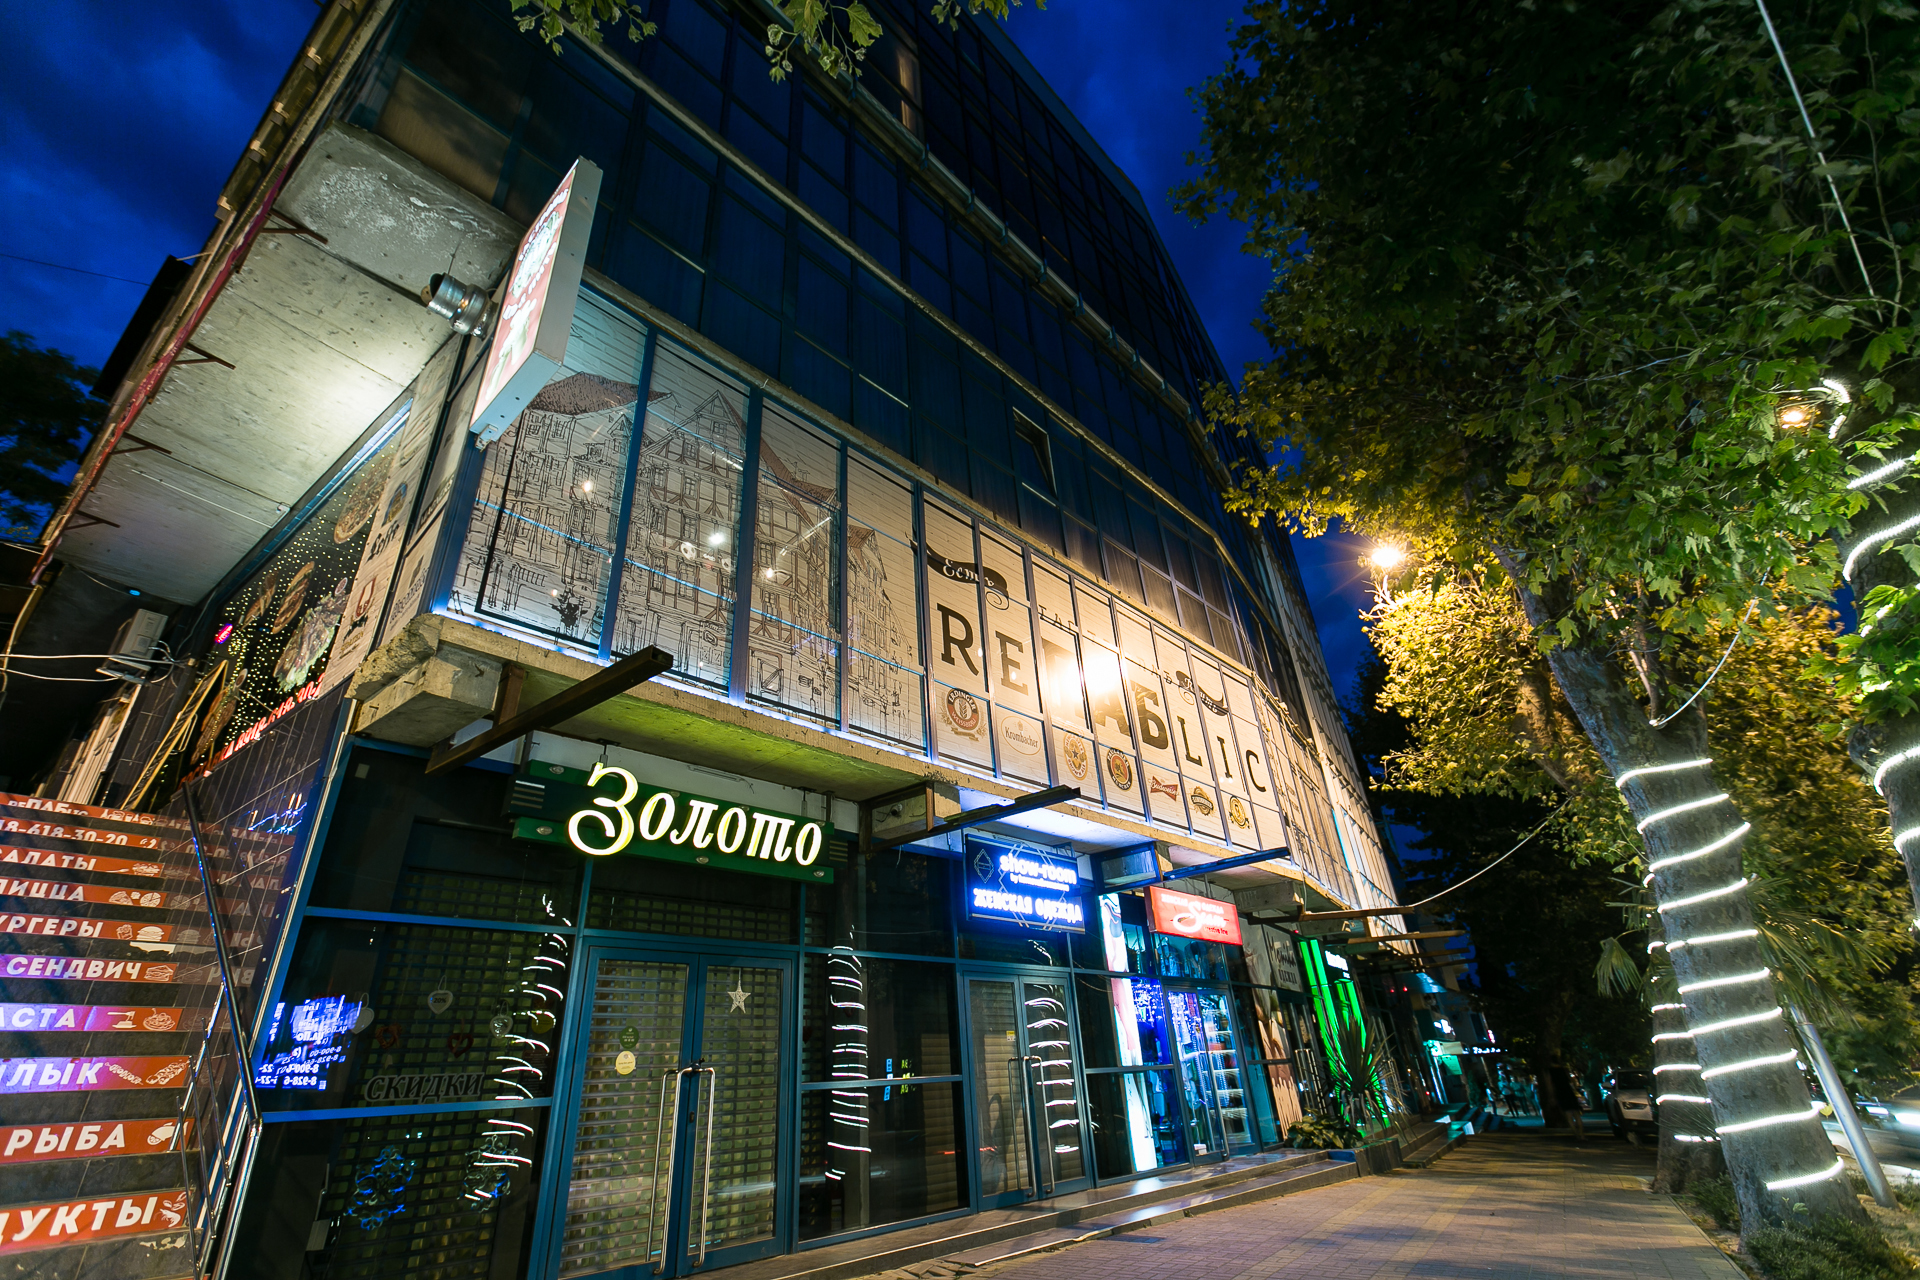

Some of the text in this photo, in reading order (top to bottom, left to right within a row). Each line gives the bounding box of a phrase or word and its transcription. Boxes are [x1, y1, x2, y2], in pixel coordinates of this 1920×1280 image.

[1004, 726, 1039, 748] Krombacher
[568, 762, 822, 865] Золото
[0, 848, 97, 871] АЛАТЫ
[6, 956, 142, 980] СЕНДВИЧ
[0, 1006, 76, 1028] СТА
[0, 1062, 103, 1087] ЛЫК
[364, 1072, 485, 1104] СКИДКИ
[4, 1123, 125, 1157] РЫБА
